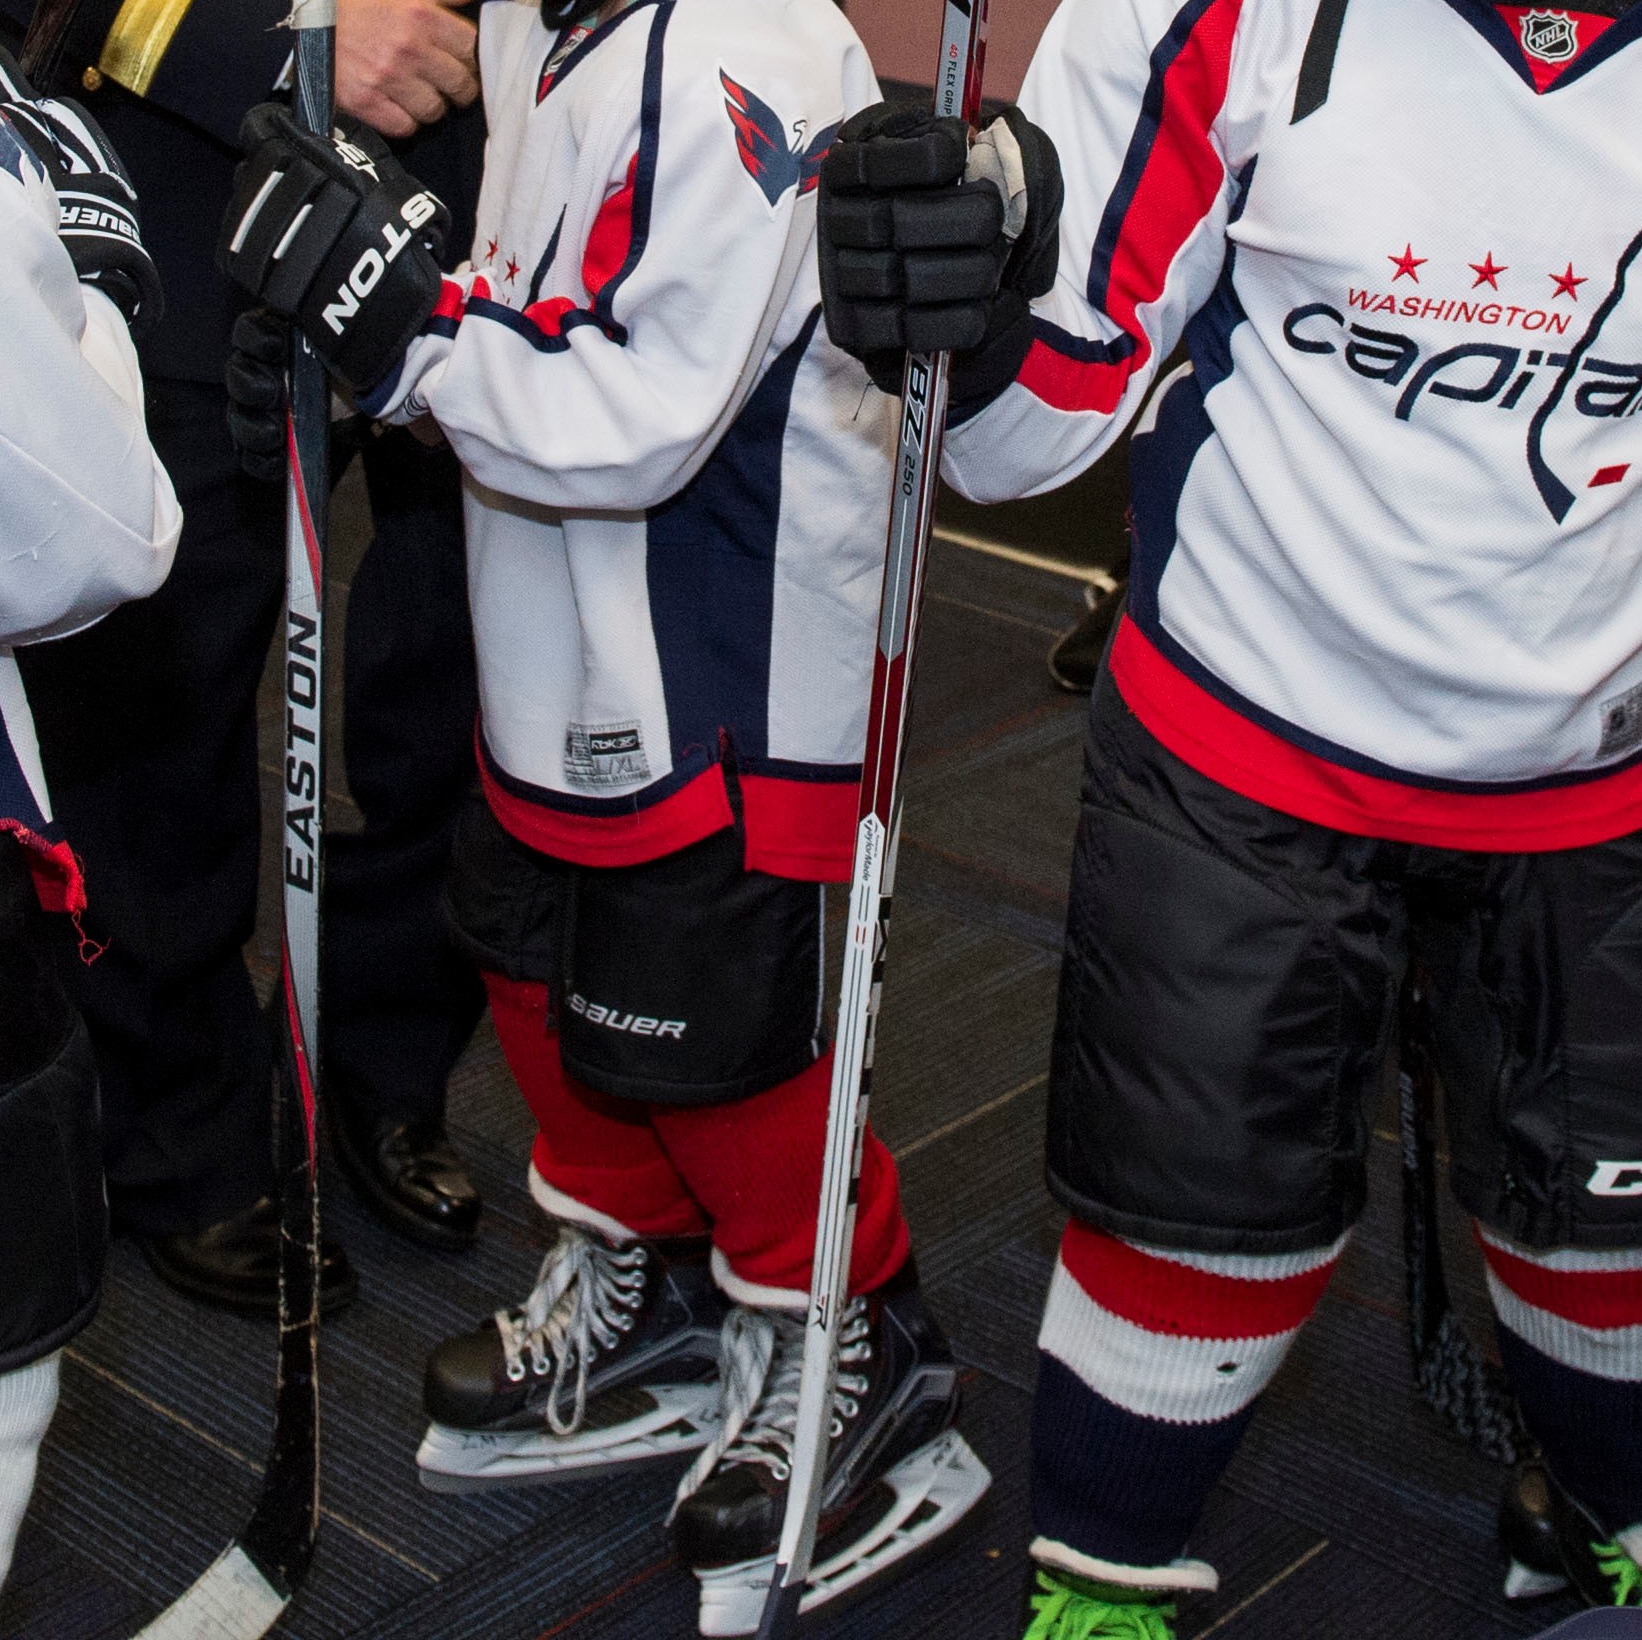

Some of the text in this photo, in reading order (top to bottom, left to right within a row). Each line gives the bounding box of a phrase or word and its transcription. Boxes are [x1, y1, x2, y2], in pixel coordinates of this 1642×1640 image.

[945, 61, 957, 89] FLEX
[1347, 287, 1573, 337] WASHINGTON
[902, 453, 916, 497] 250
[285, 610, 321, 895] EASTON
